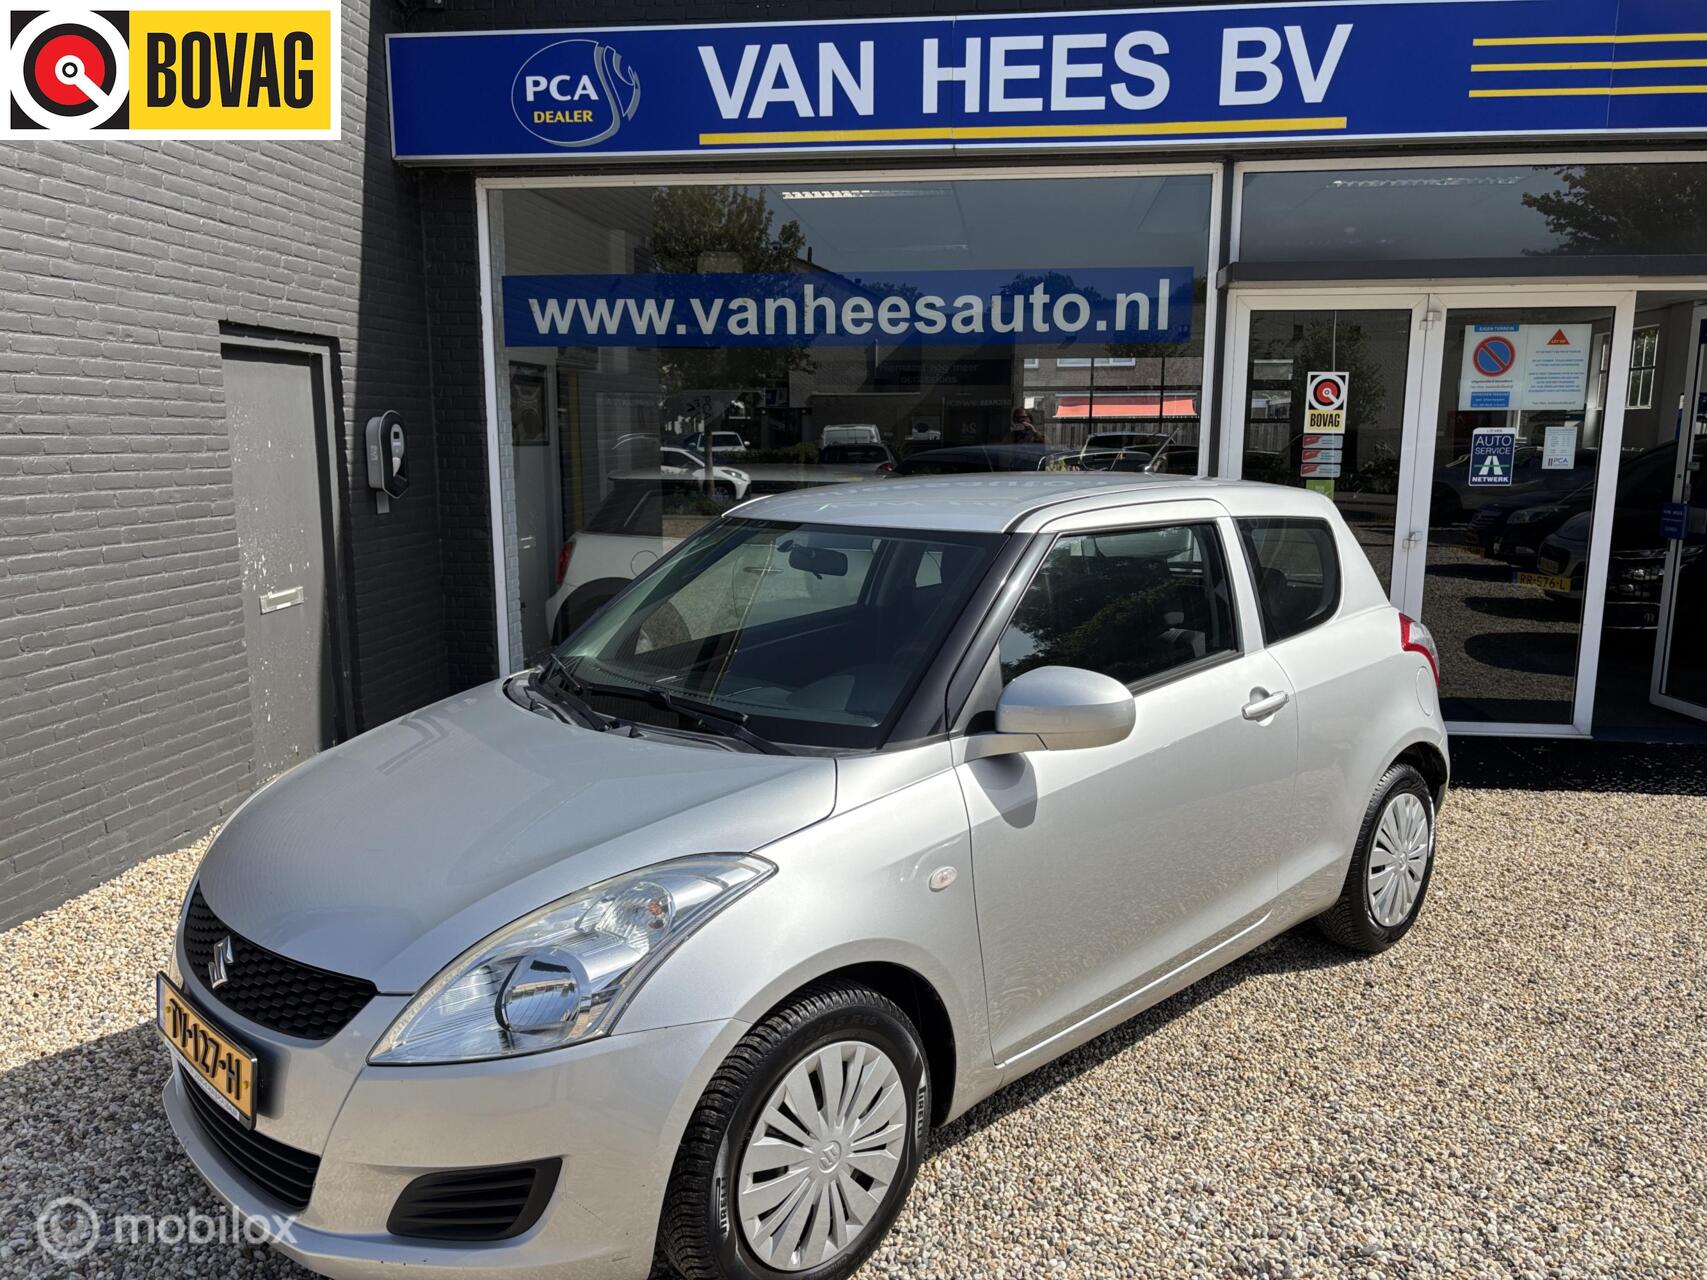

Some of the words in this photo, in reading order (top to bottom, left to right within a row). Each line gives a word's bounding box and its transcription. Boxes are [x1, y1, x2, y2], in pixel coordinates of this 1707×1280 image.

[698, 40, 875, 119] VAN
[923, 31, 1170, 114] HEES
[1219, 24, 1354, 106] BV
[525, 75, 599, 102] PCA
[533, 110, 593, 123] DEALER
[528, 279, 1169, 335] www.vanheesauto.nl
[1310, 413, 1341, 427] BOVAG
[1475, 435, 1512, 446] AUTO
[1474, 447, 1511, 455] SERVICE
